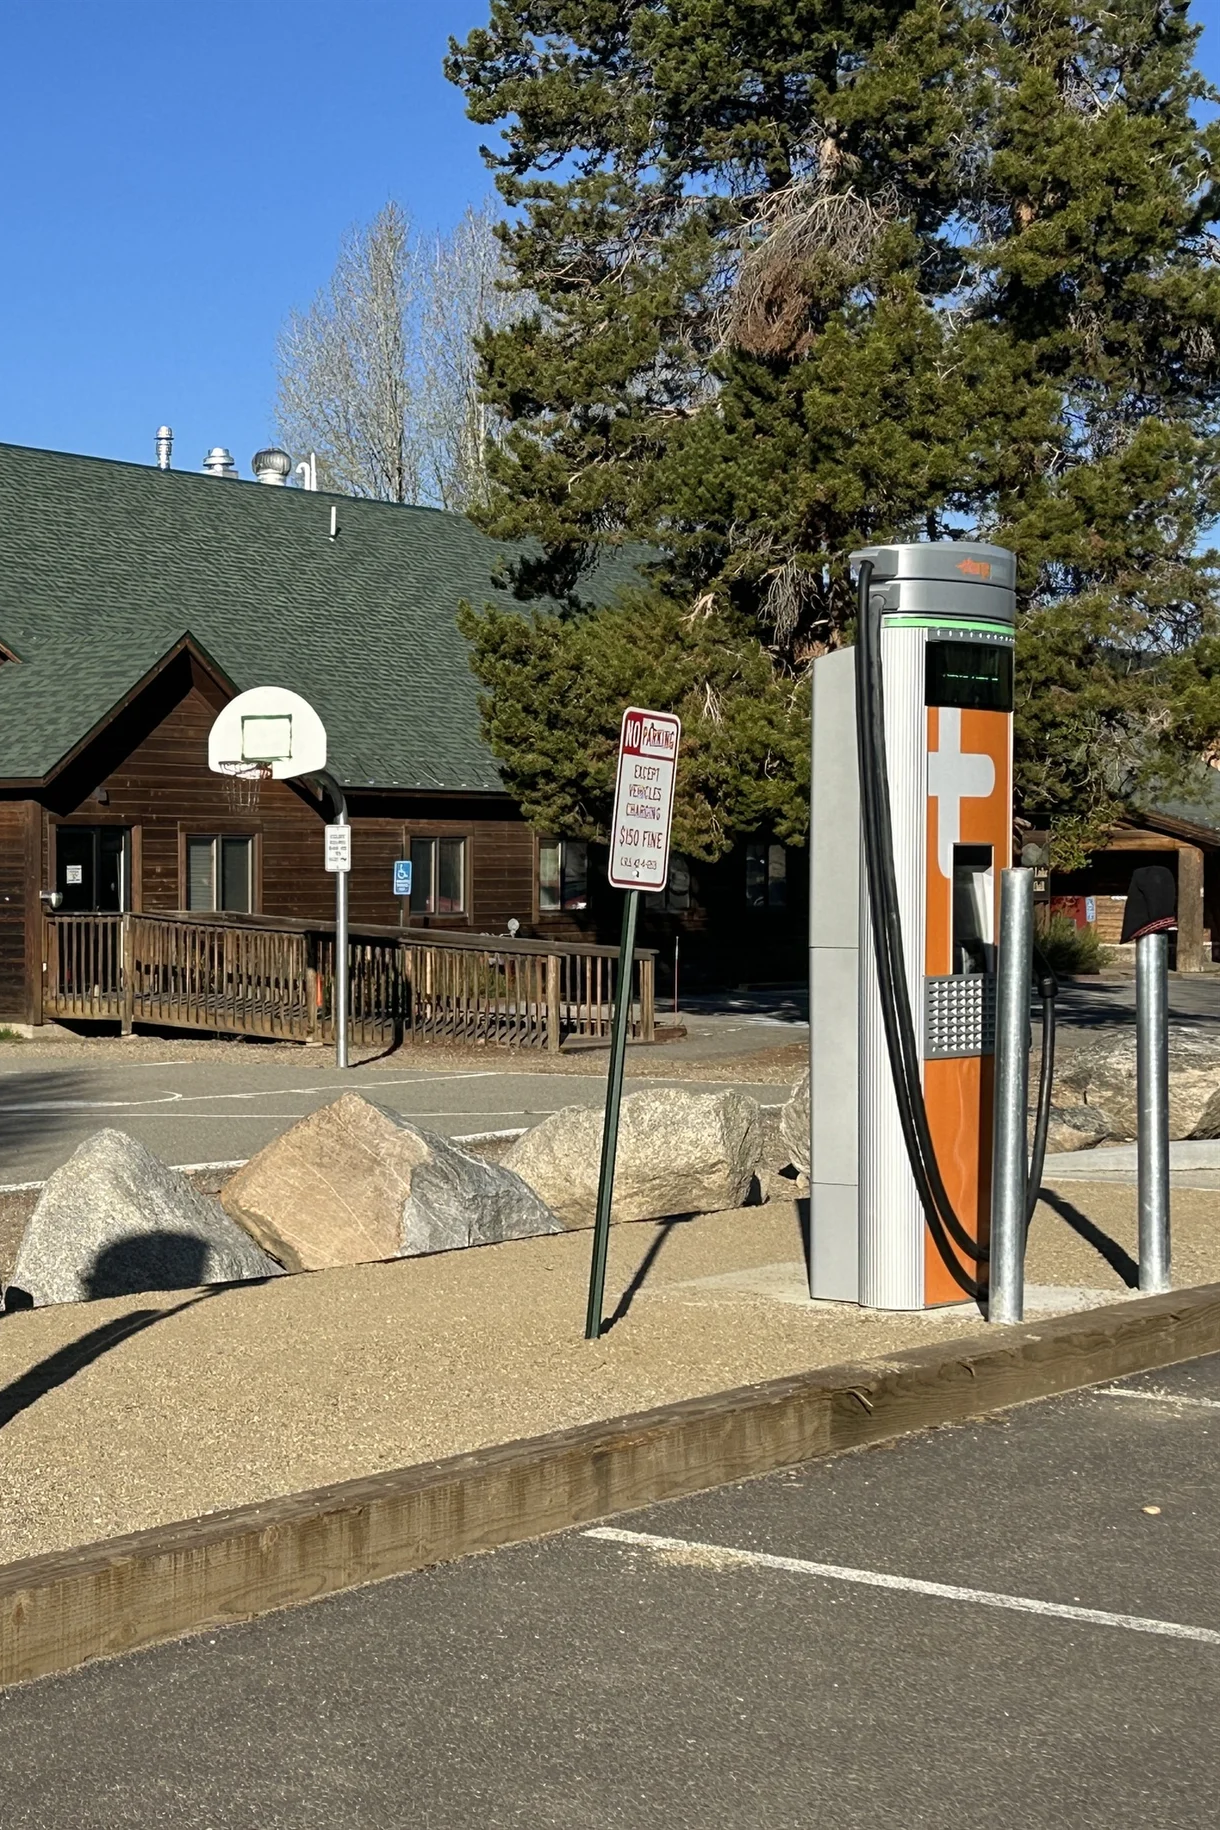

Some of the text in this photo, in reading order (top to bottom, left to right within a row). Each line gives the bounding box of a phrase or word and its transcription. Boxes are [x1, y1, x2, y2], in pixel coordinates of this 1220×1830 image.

[625, 720, 641, 748] NO
[620, 825, 663, 849] $150 FINE
